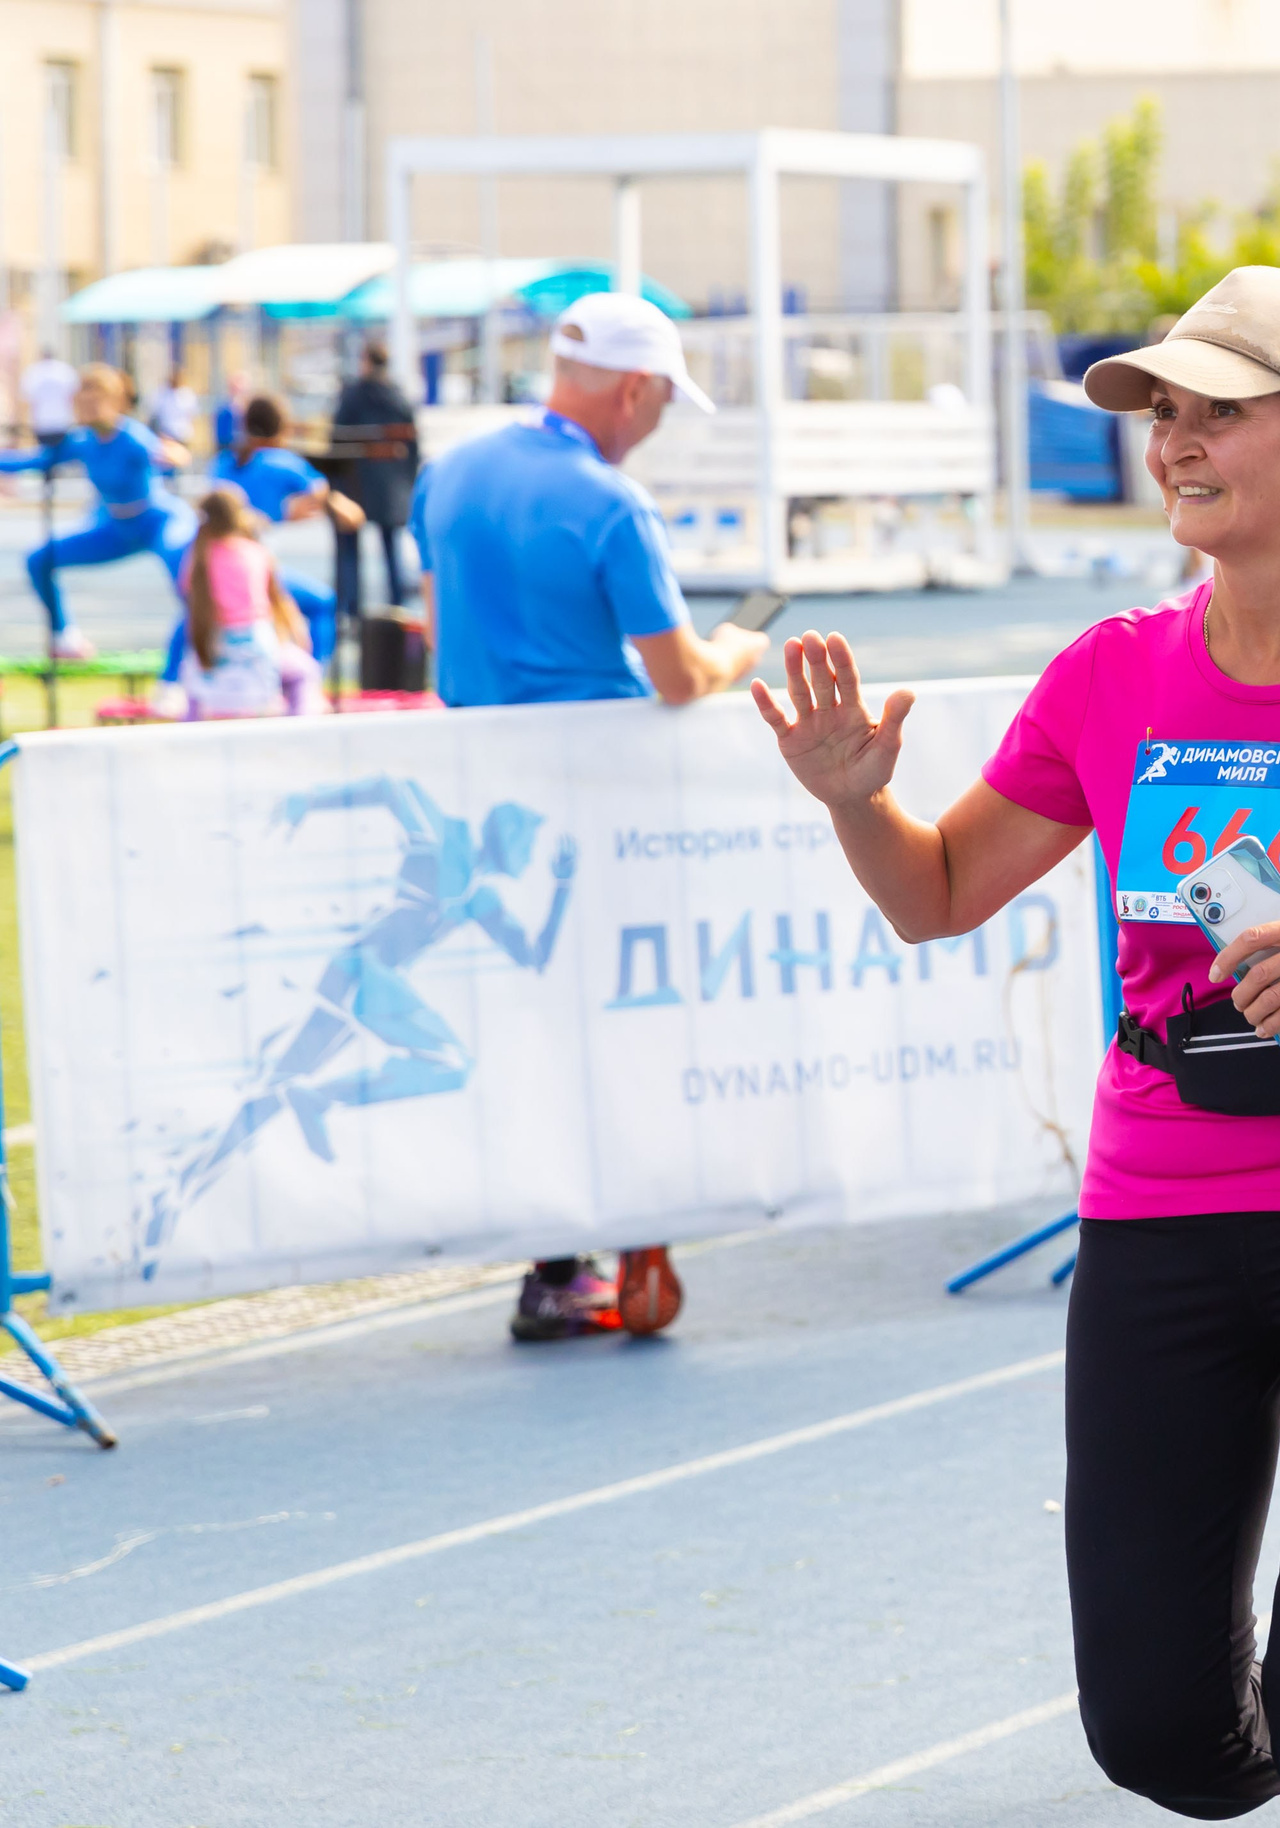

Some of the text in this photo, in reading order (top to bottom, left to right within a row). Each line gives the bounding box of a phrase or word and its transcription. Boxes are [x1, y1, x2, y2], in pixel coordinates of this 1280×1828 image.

[1216, 765, 1268, 782] МИЛЯ
[615, 819, 835, 860] История стр
[682, 1037, 1022, 1106] DYNAMO-UDM.RU
